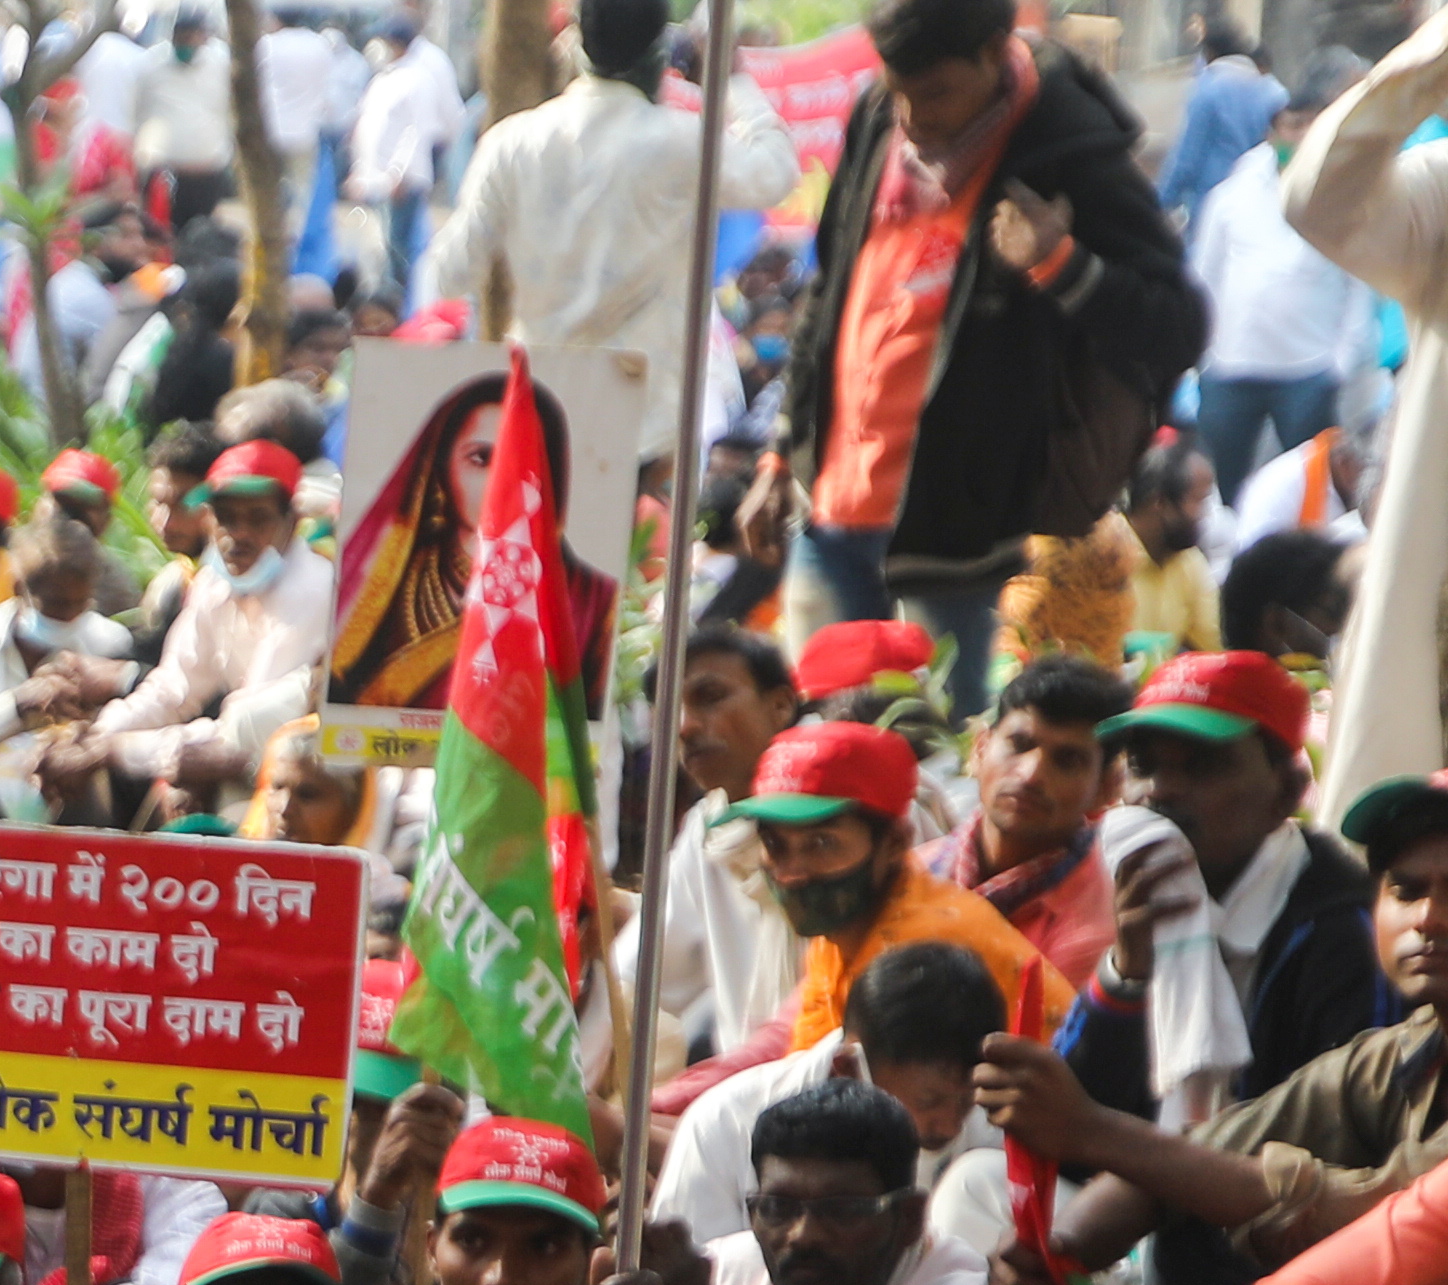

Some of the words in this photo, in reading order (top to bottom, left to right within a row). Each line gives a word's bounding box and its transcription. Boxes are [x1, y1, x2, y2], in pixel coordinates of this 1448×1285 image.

[67, 849, 105, 904] में
[120, 864, 221, 911] २००
[235, 863, 317, 927] दिन
[66, 926, 160, 971] काम
[171, 921, 219, 984] दो
[10, 983, 68, 1026] का
[78, 990, 153, 1047] पूरा
[164, 996, 246, 1047] दाम
[256, 990, 305, 1054] दो
[72, 1079, 195, 1147] संघर्ष
[208, 1089, 331, 1159] मोर्चा
